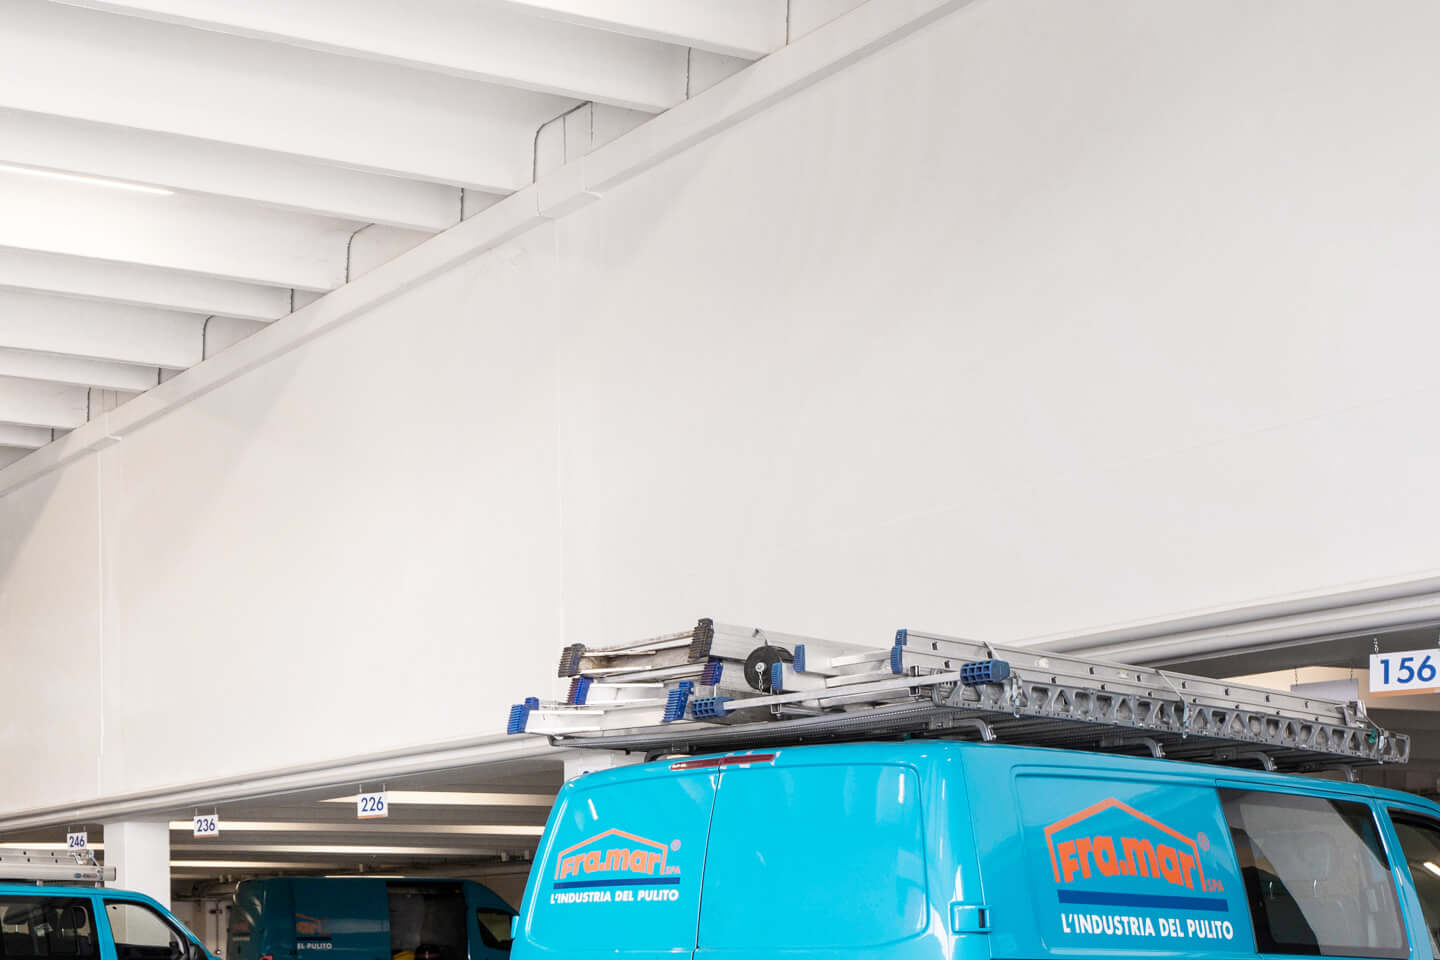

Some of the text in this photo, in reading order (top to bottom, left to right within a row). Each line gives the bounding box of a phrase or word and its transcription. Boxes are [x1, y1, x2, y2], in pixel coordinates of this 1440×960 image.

[1380, 655, 1436, 685] 156
[361, 796, 384, 813] 226
[196, 818, 216, 833] 236
[69, 835, 85, 848] 246
[1206, 878, 1224, 893] SPA
[550, 889, 679, 904] L'INDUSTRIA DEL PULITO
[1061, 913, 1234, 940] L'INDUSTRIA DEL PULITO
[306, 942, 333, 950] PULITO
